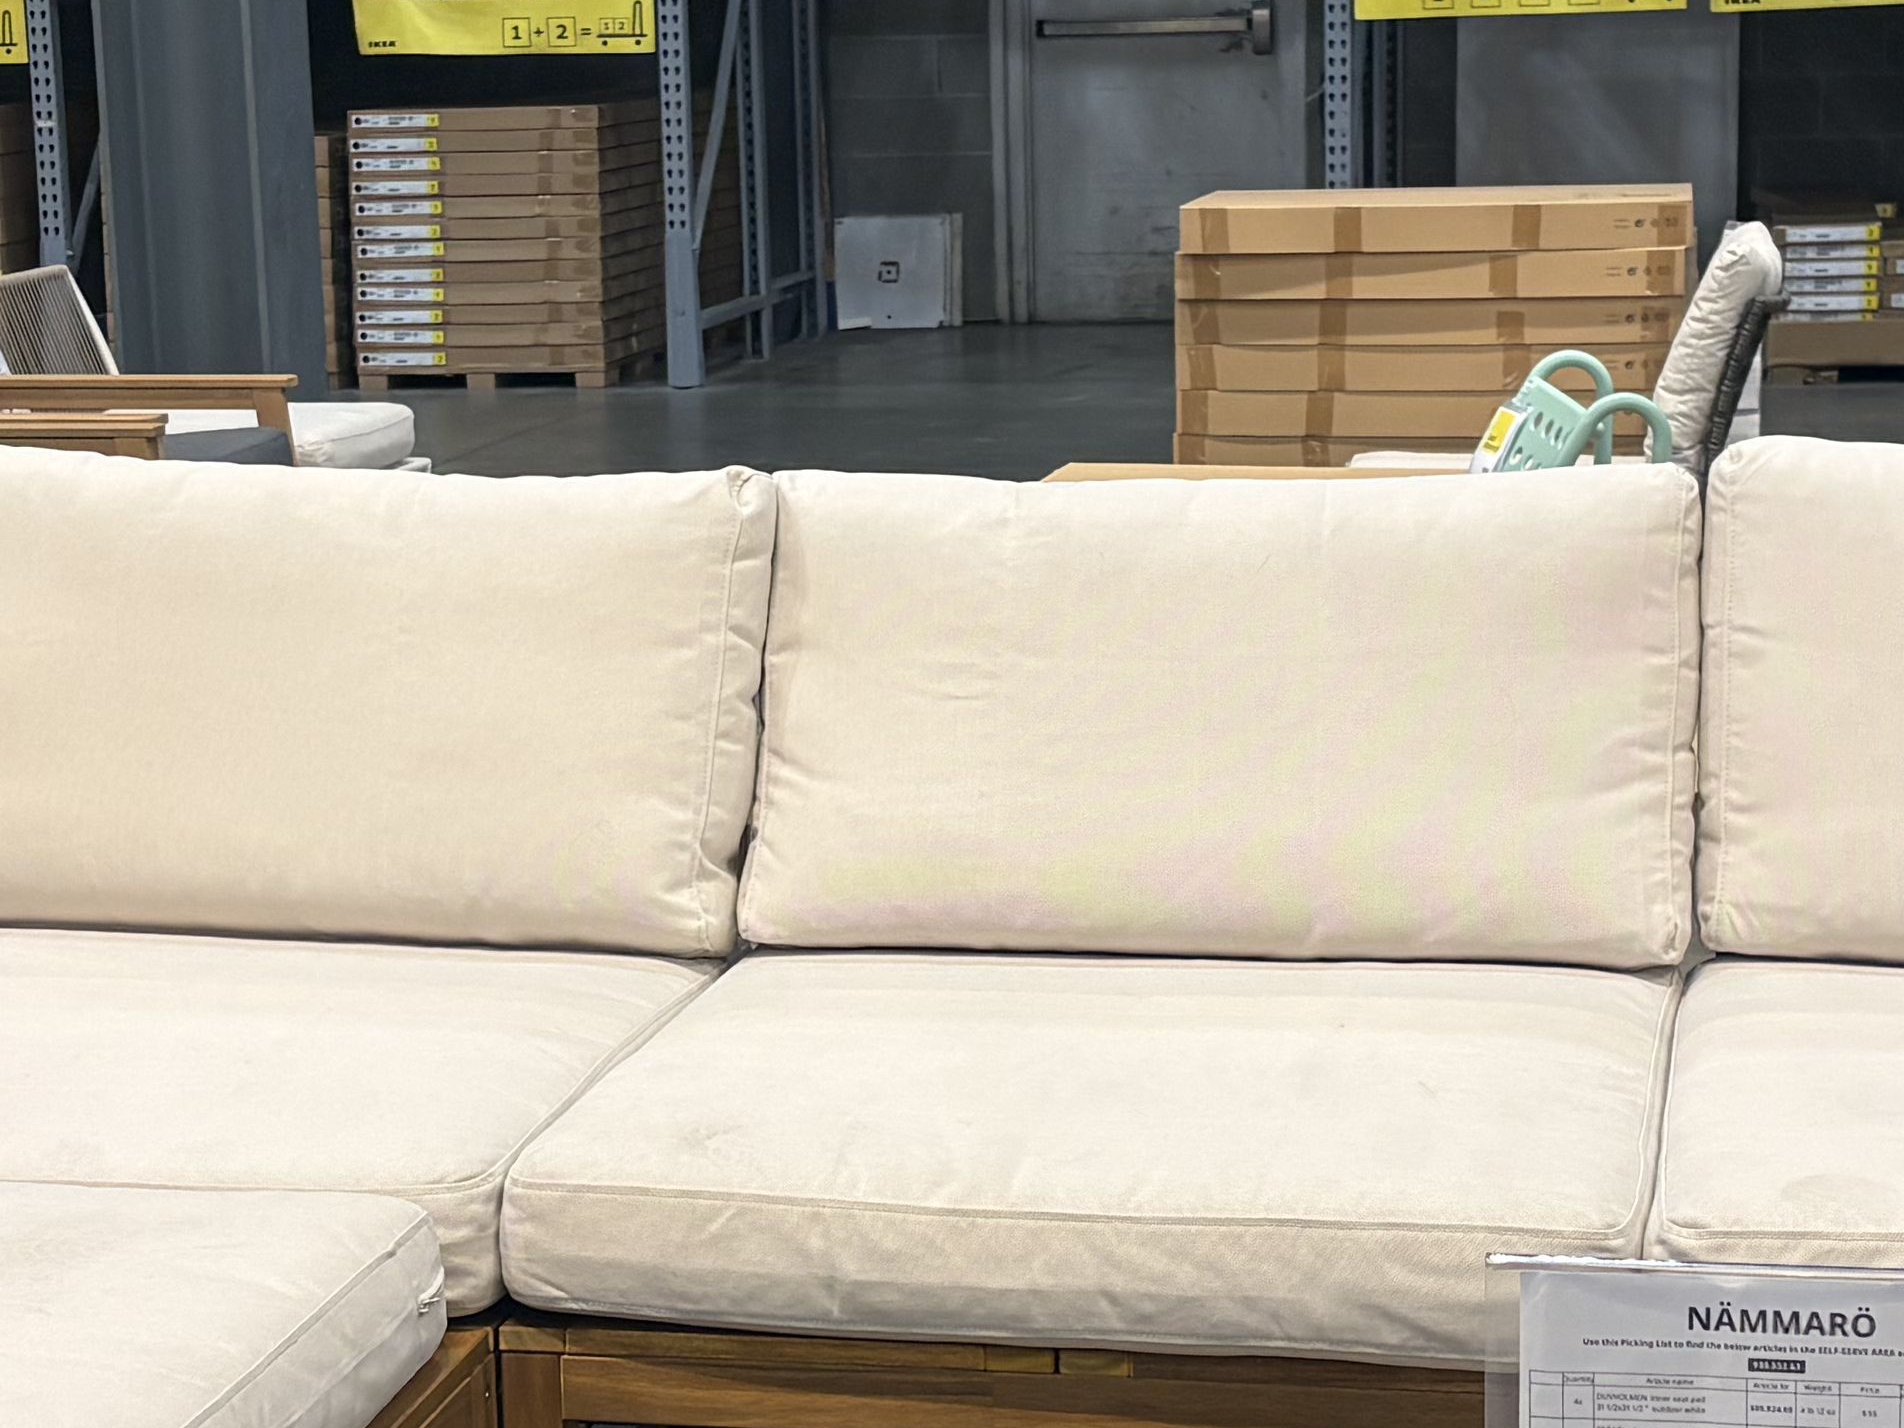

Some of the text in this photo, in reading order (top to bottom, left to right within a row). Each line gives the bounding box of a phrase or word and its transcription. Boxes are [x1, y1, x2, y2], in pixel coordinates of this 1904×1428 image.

[512, 25, 568, 40] 1 2
[1688, 1301, 1876, 1338] NÄMMARÖ
[1621, 1339, 1654, 1349] Picking
[1674, 1341, 1684, 1349] to
